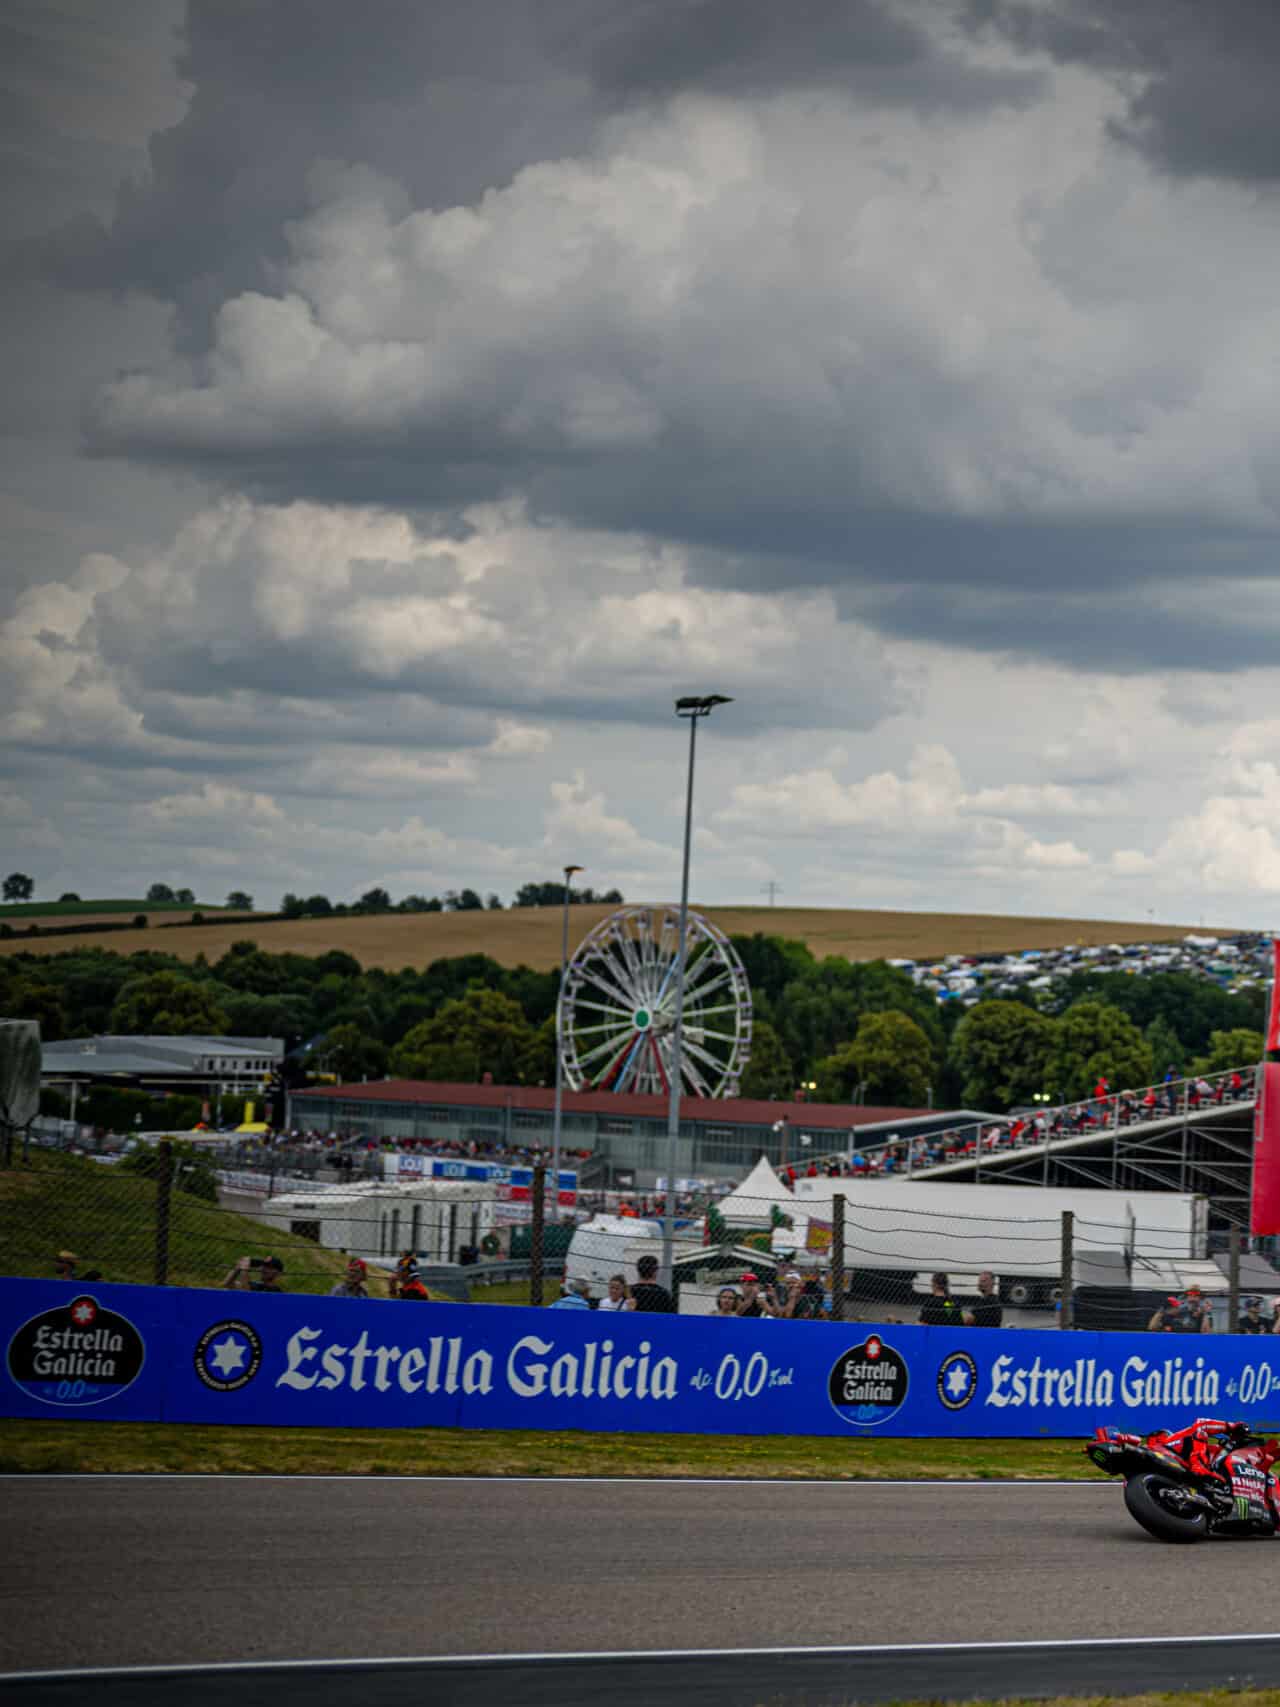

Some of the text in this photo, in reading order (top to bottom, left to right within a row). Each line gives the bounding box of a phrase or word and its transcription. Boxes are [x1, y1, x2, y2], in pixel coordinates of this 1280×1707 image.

[33, 1325, 123, 1352] Estrella
[33, 1351, 116, 1376] Galicia
[275, 1326, 494, 1395] Estrella
[507, 1335, 679, 1400] Galicia
[843, 1360, 897, 1380] Estrella
[843, 1381, 893, 1400] Galicia
[984, 1354, 1115, 1407] Estrella
[1120, 1356, 1220, 1407] Galicia
